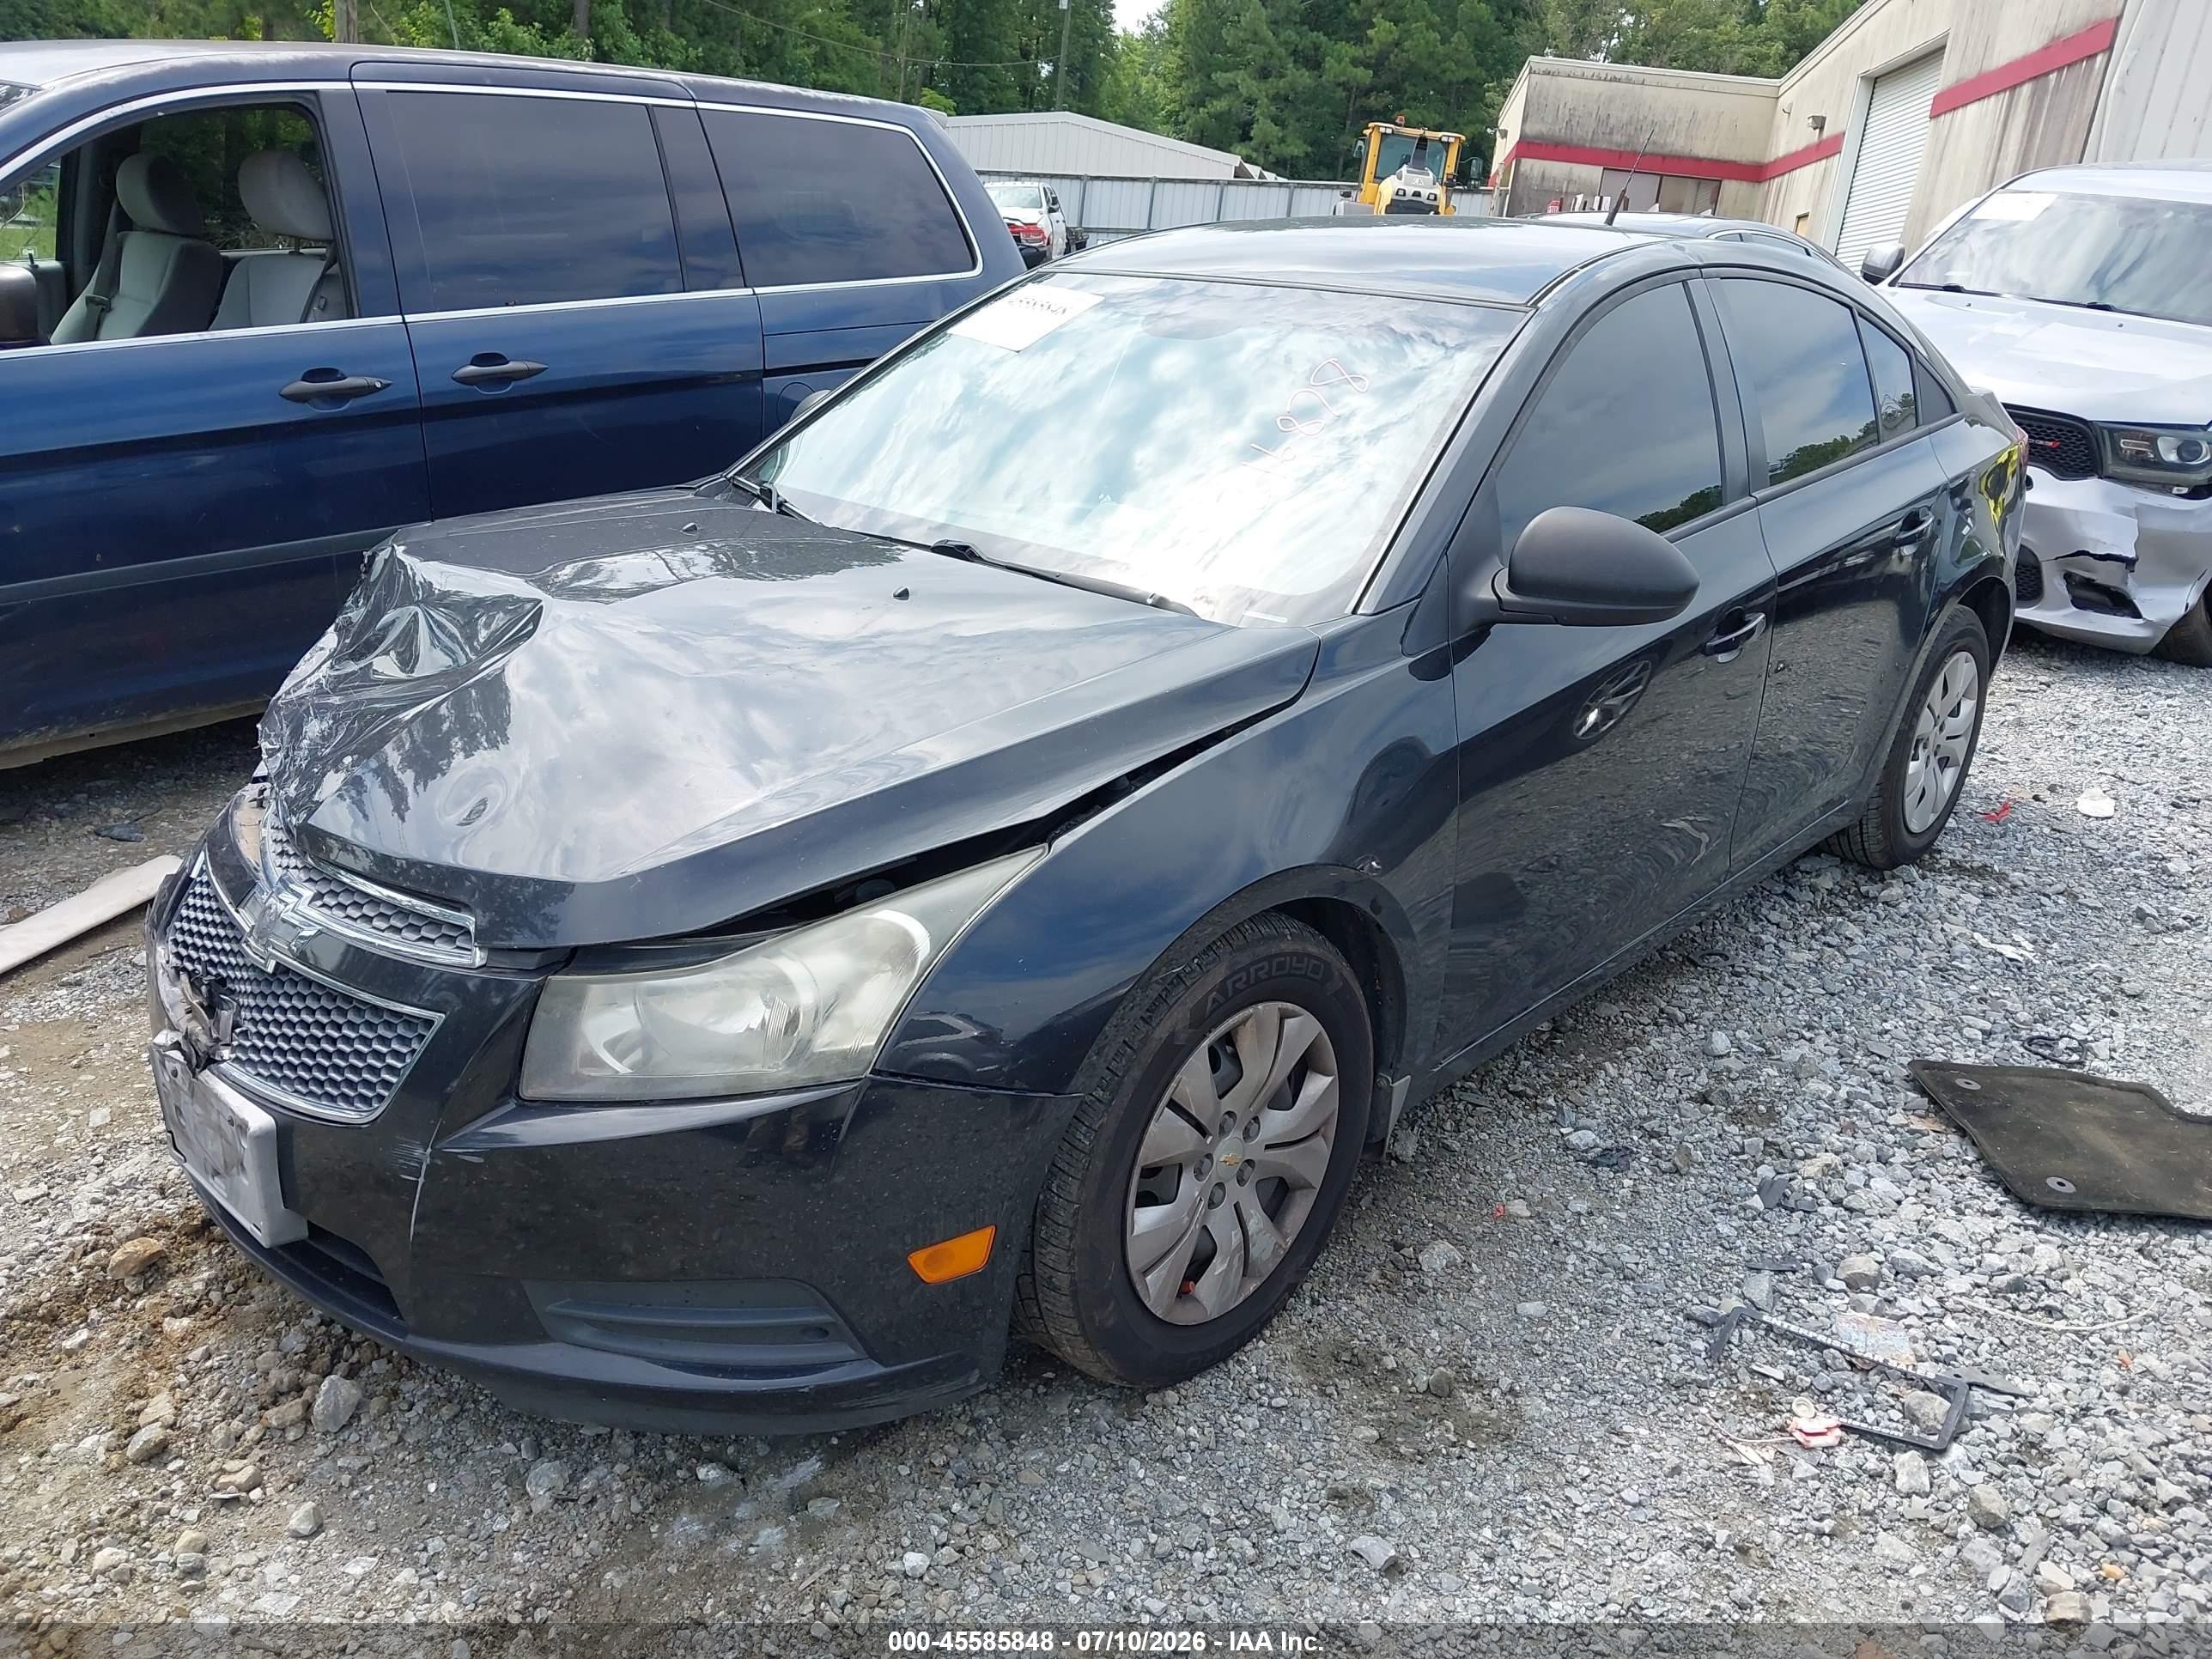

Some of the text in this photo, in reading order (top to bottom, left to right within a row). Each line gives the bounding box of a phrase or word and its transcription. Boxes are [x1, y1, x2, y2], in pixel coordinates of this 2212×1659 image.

[1206, 955, 1325, 1017] ARROYO
[1762, 1315, 1936, 1379] ENTERPRISE CAR SALES
